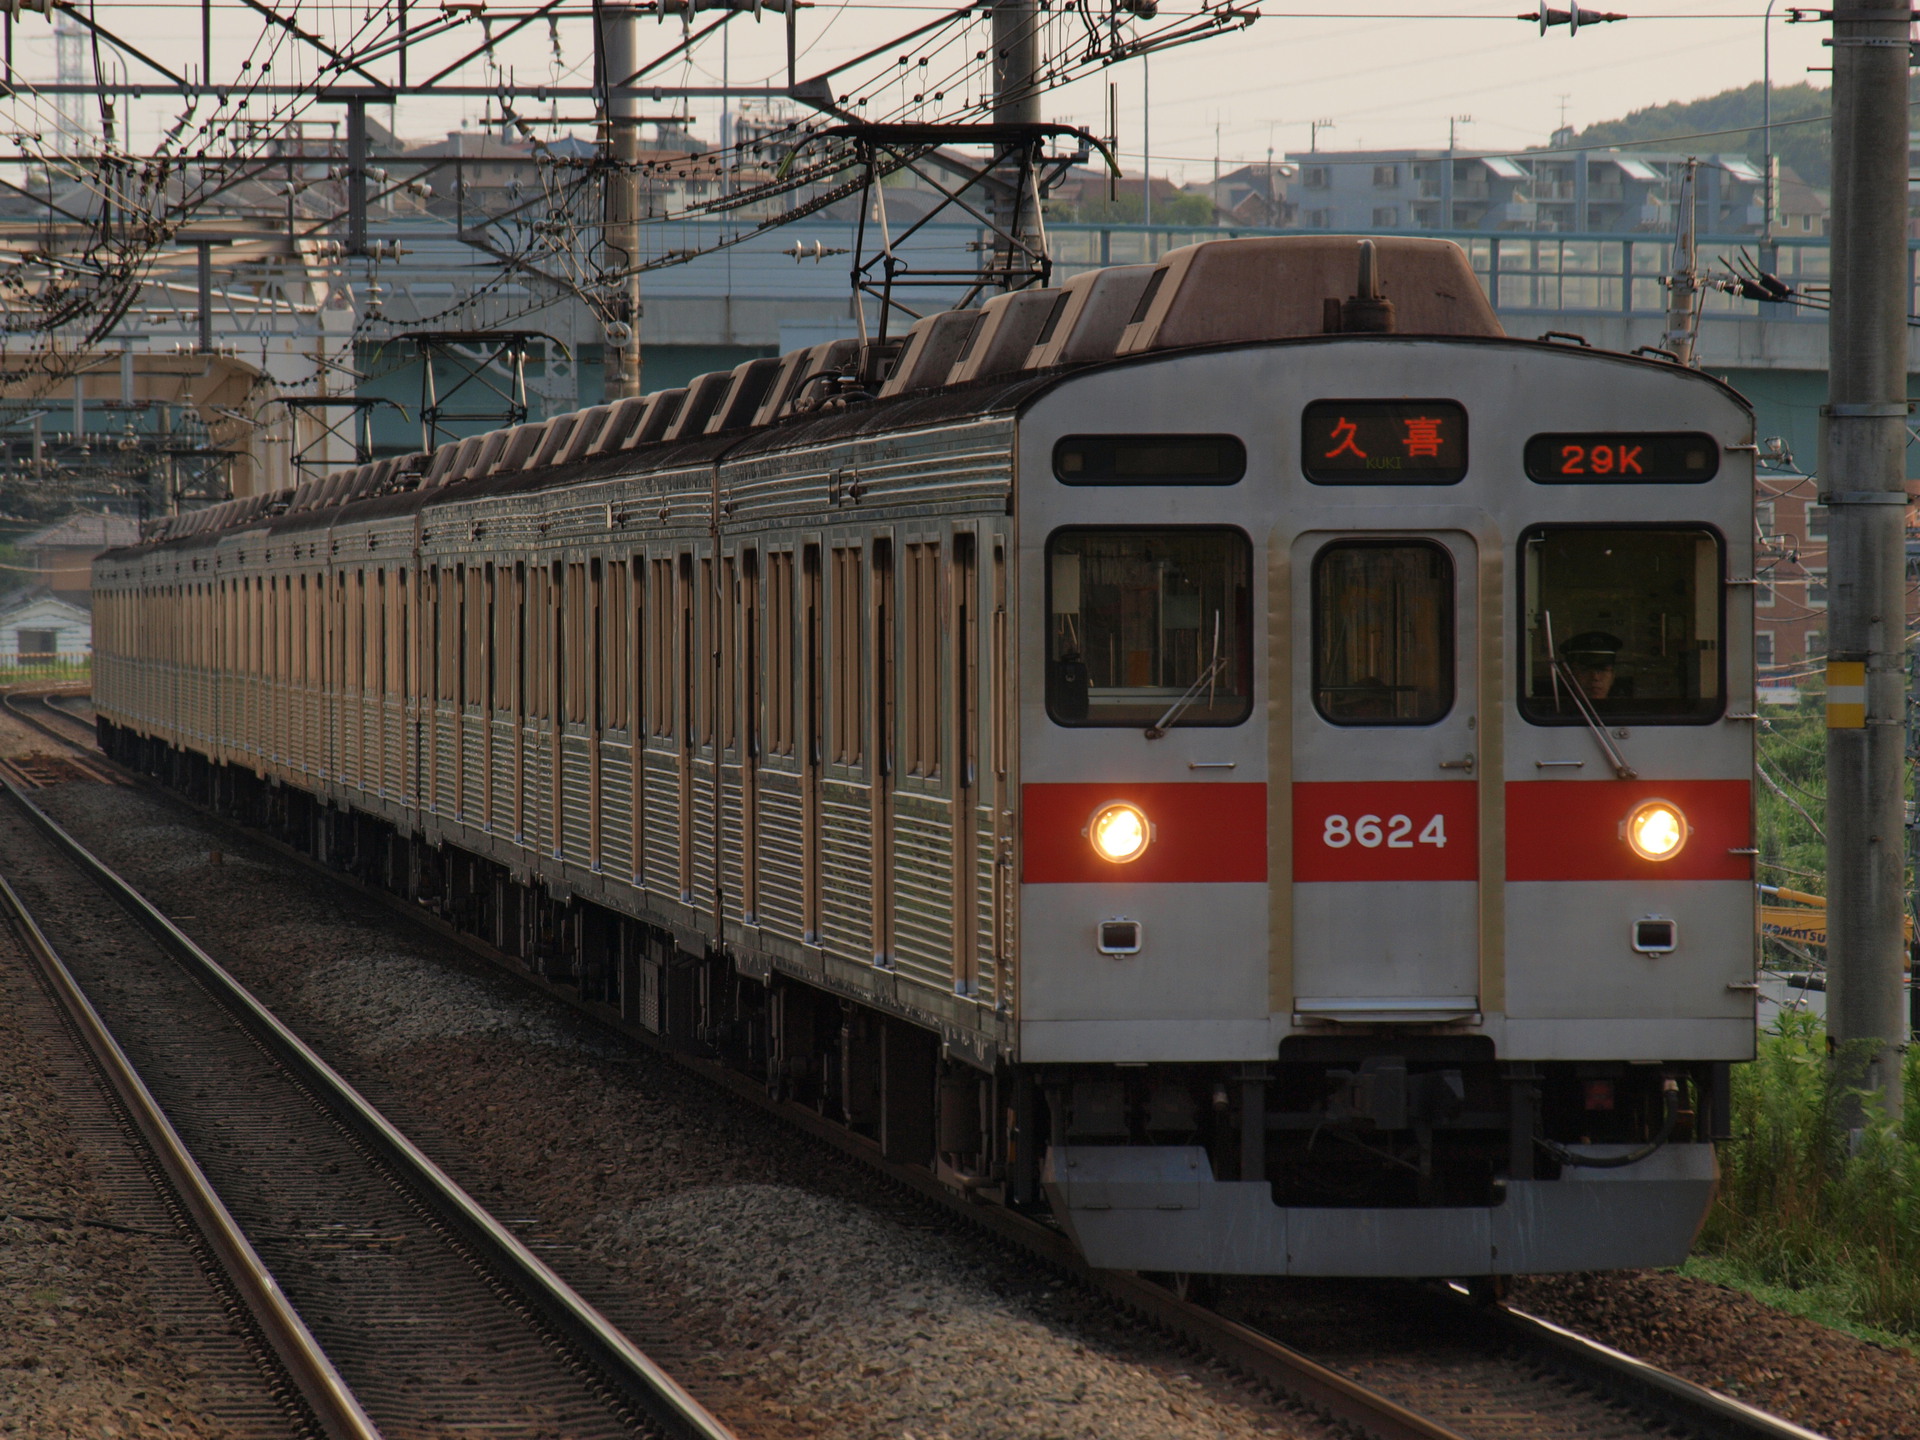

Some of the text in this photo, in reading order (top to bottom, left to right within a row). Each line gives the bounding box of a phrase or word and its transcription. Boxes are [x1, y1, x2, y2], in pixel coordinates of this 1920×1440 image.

[1325, 416, 1444, 458] 久喜
[1366, 457, 1402, 469] KUKI
[1561, 445, 1643, 474] 29K
[1323, 814, 1447, 848] 8624
